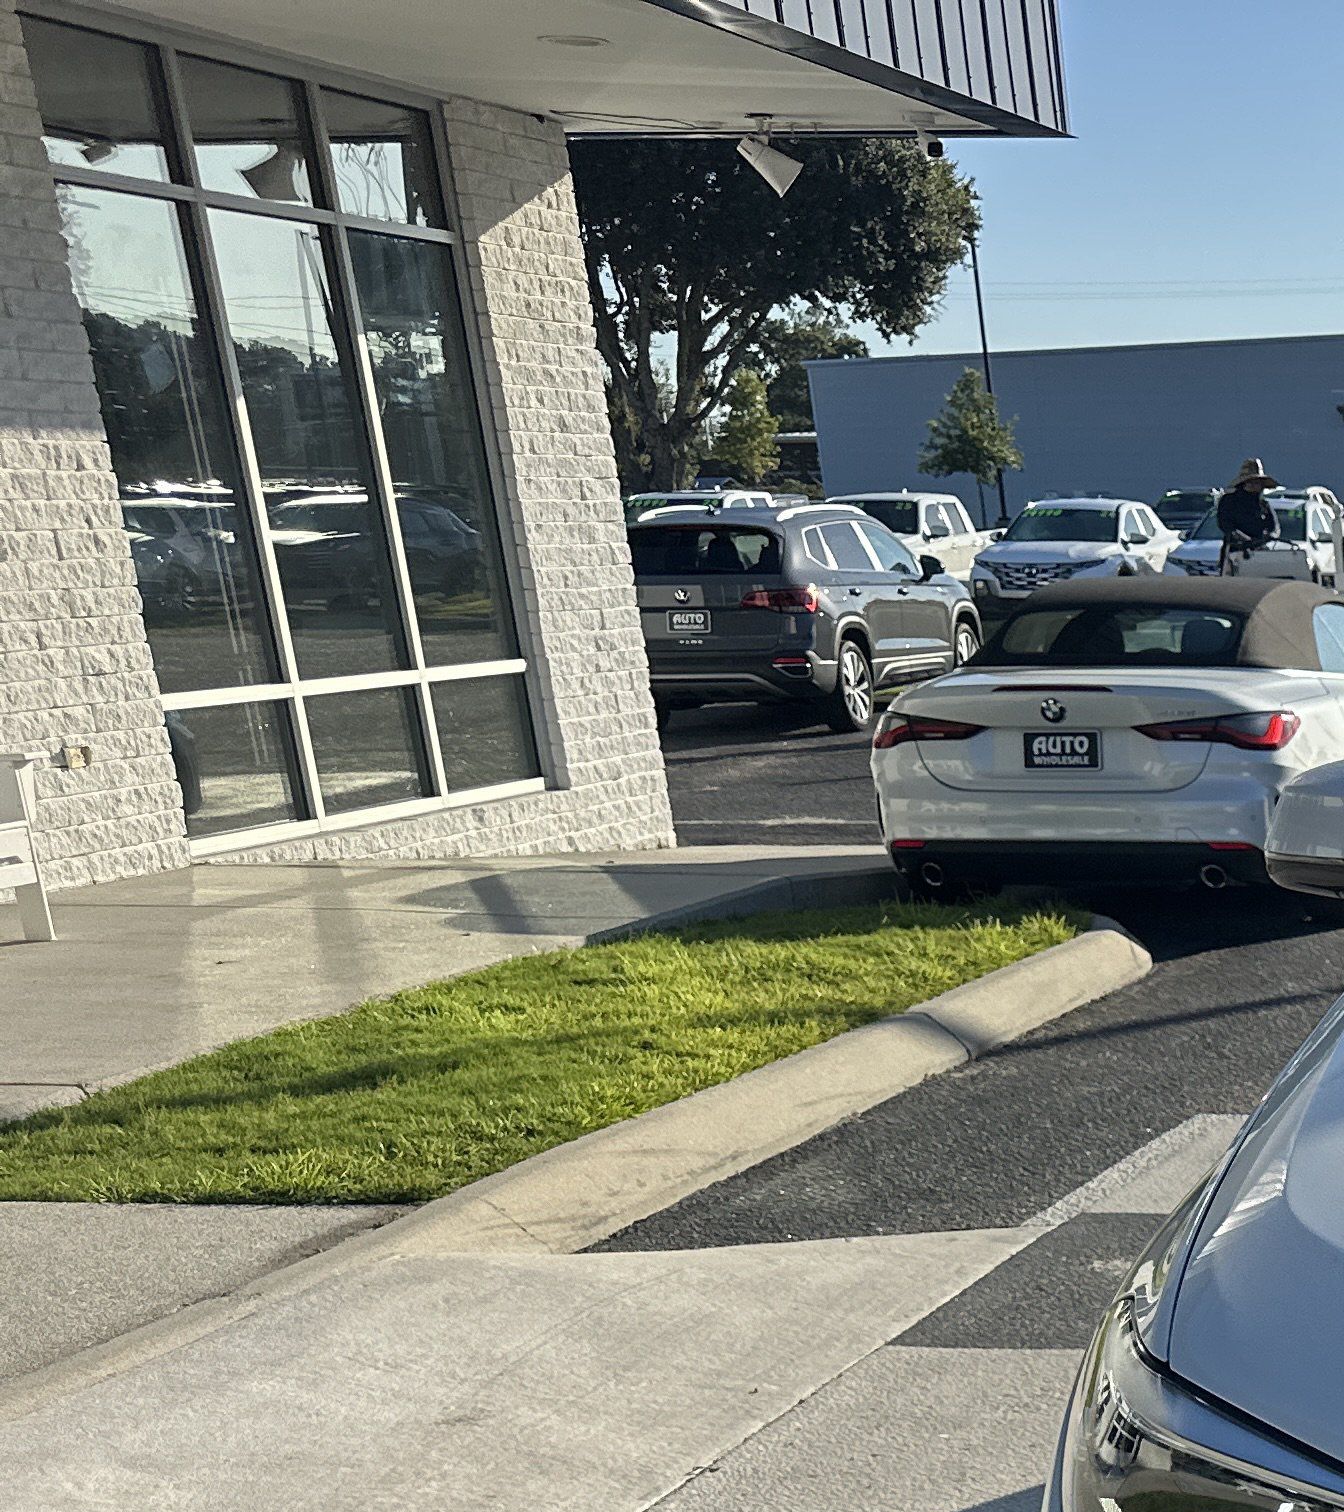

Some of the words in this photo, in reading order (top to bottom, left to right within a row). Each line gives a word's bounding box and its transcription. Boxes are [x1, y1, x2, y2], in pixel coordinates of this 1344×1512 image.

[672, 613, 704, 624] AUTO
[1032, 735, 1090, 755] AUTO
[1033, 755, 1091, 766] WHOLESALE
